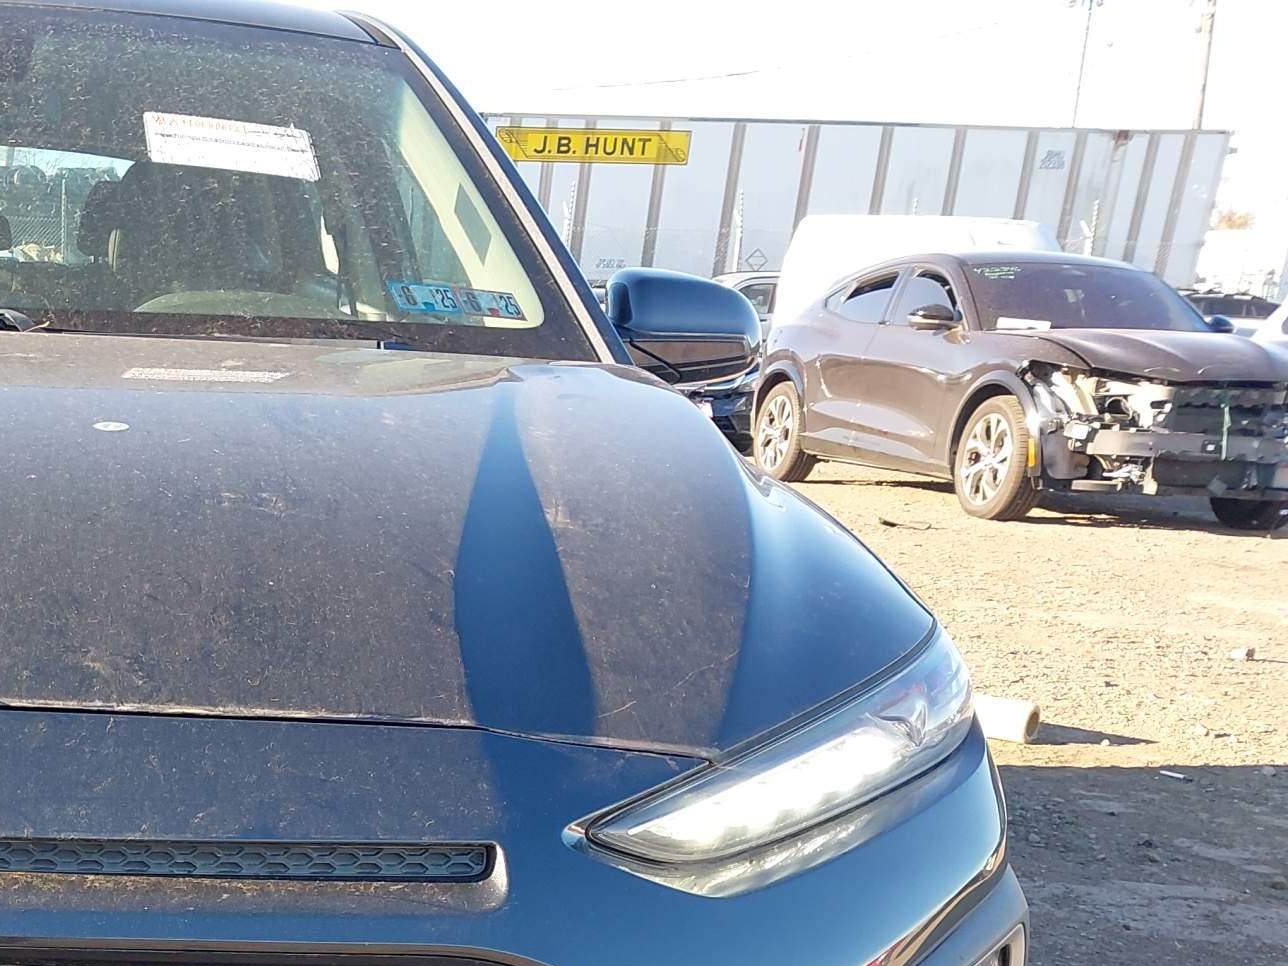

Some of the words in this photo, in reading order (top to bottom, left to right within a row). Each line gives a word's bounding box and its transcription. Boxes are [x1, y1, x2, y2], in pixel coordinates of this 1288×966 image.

[533, 135, 577, 155] J.B.
[584, 136, 652, 157] HUNT
[435, 288, 457, 309] 25
[500, 295, 521, 316] 25
